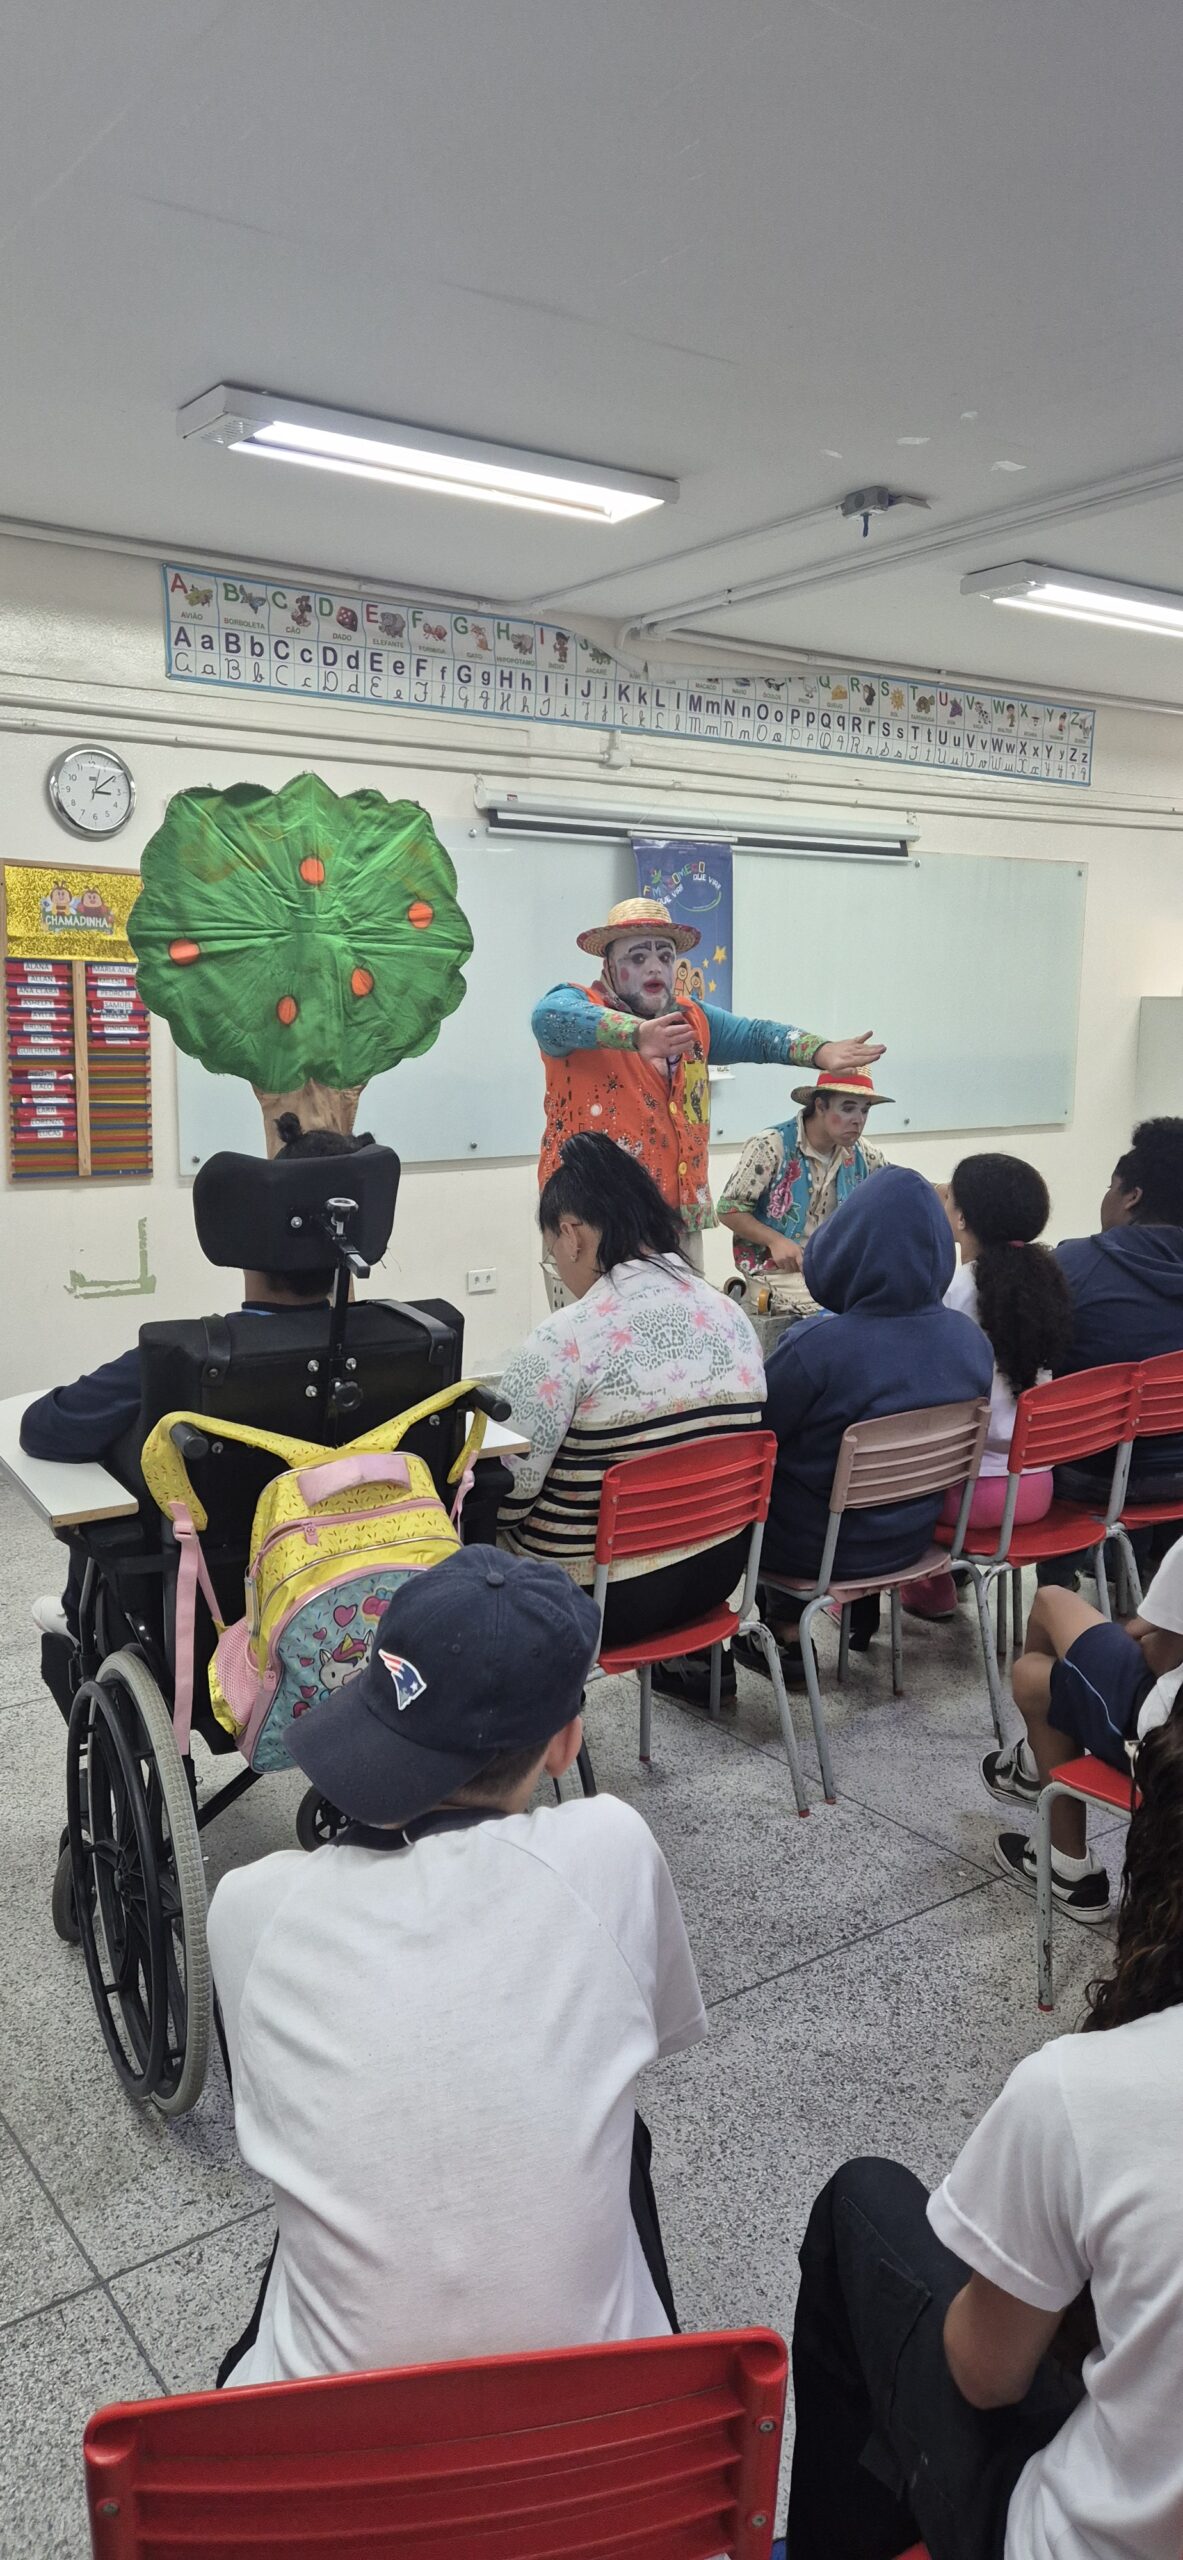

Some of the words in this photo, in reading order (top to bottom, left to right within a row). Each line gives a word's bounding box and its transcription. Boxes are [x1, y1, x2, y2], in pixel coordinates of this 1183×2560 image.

[170, 573, 188, 594] A
[223, 582, 240, 602] B
[272, 591, 288, 610] C
[319, 597, 334, 616] D
[366, 604, 378, 624] E
[412, 610, 424, 628] F
[453, 616, 468, 635] G
[496, 622, 510, 640] H
[850, 677, 860, 692] R
[881, 681, 889, 696] S
[910, 685, 918, 700] T
[940, 691, 948, 706] U
[966, 695, 974, 710] V
[993, 700, 1005, 715] W
[1020, 703, 1028, 718] X
[1046, 708, 1054, 722] Y
[1070, 712, 1080, 726] Z
[180, 610, 204, 621] AVIÃO
[224, 617, 265, 630] BORBOLETA
[286, 626, 300, 634] CÃO
[332, 632, 352, 642] DADO
[372, 638, 404, 649] ELEFANTE
[695, 682, 717, 690] MACACO
[68, 774, 77, 782] 10
[92, 813, 98, 821] 6
[105, 810, 110, 818] 5
[693, 873, 706, 882] QUE
[46, 915, 109, 928] CHAMADINHA
[34, 988, 58, 996] CLARA
